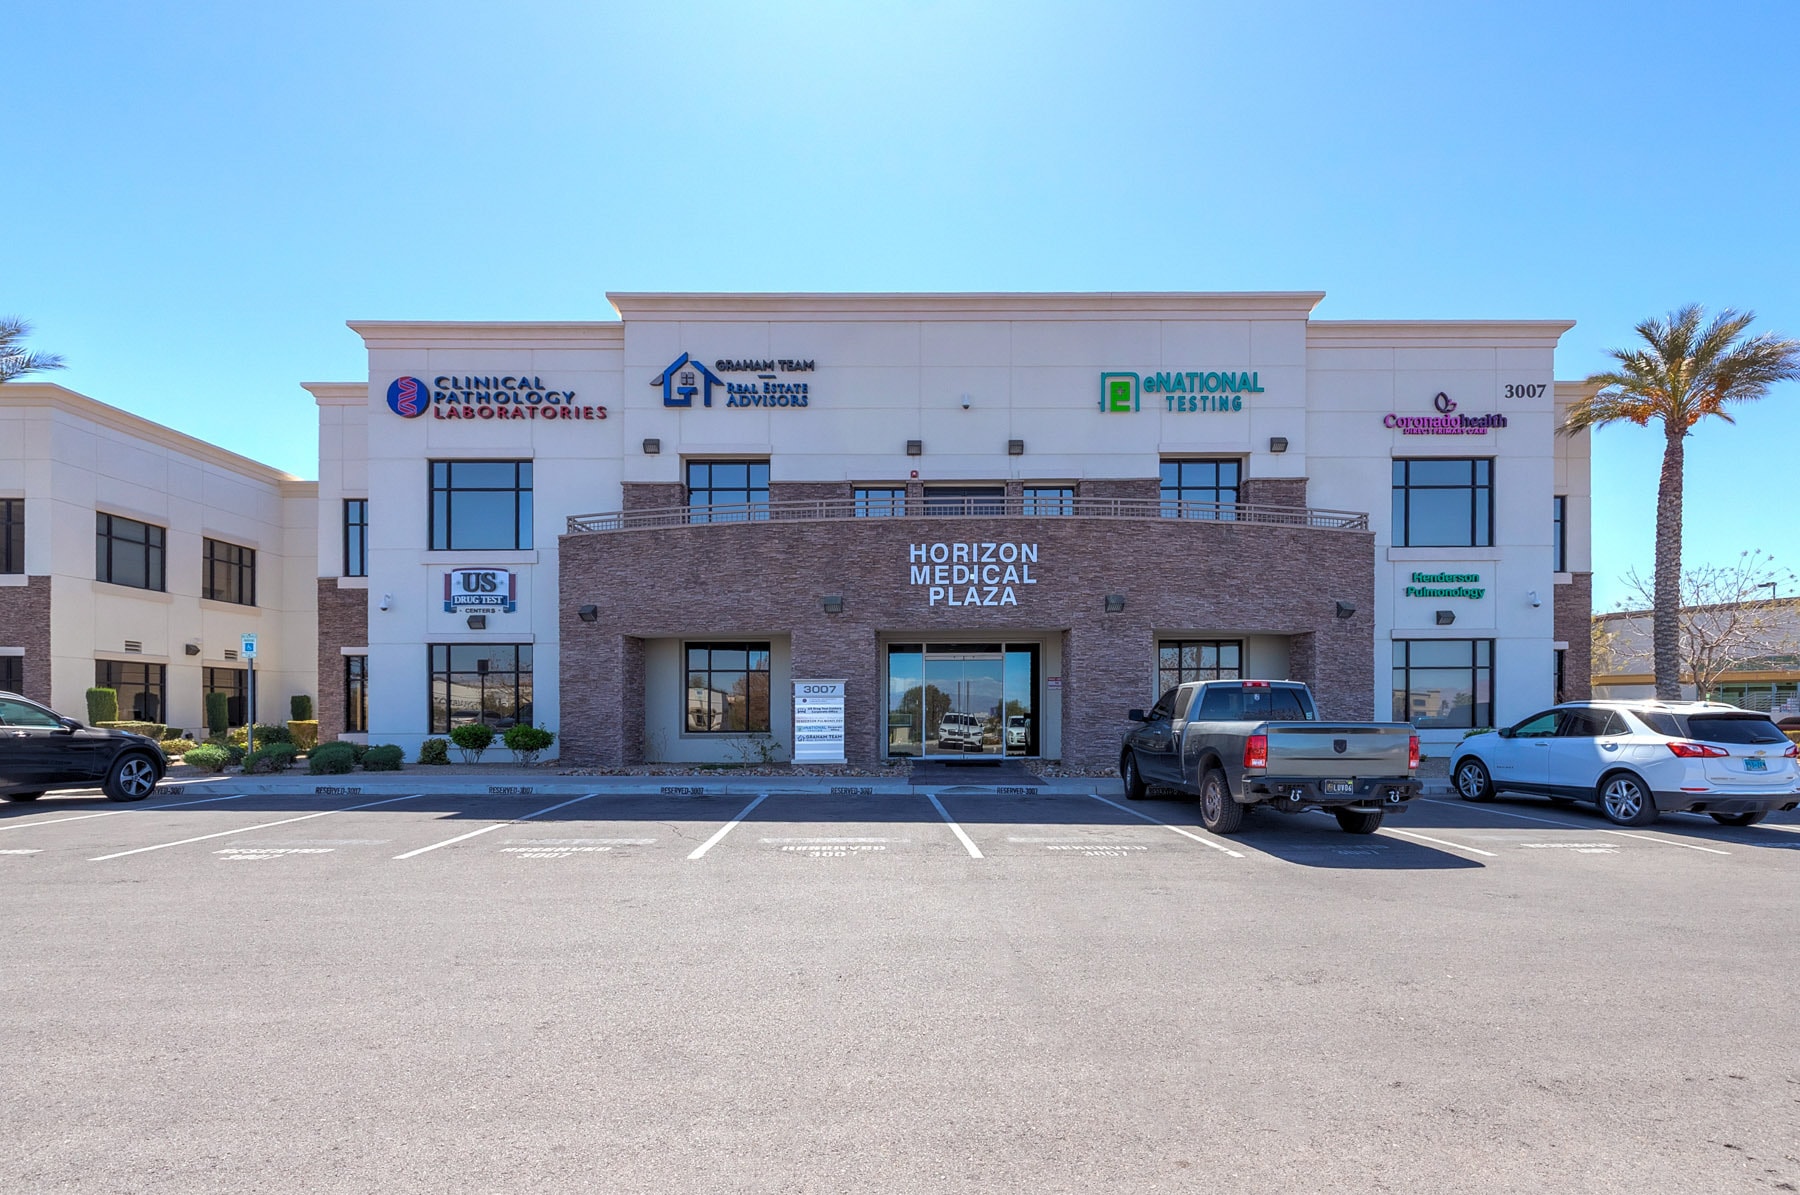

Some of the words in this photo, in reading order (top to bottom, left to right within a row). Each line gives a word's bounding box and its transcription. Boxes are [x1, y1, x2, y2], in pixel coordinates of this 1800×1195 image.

[715, 359, 775, 372] GRAHAM
[778, 359, 815, 372] TEAM
[433, 376, 546, 390] CLINICAL
[726, 382, 759, 394] REAL
[763, 382, 808, 394] ESTATE
[1143, 371, 1265, 393] eNATIONAL
[433, 390, 576, 405] PATHOLOGY
[1504, 384, 1547, 399] 3007
[726, 394, 808, 408] ADVISORS
[1165, 395, 1243, 412] TESTING
[433, 405, 608, 420] LABORATORIES
[909, 542, 1038, 563] HORIZON
[909, 564, 1037, 585] MEDICAL
[1412, 572, 1480, 583] Henderson
[460, 572, 497, 593] US
[454, 595, 479, 604] DRUG
[480, 595, 503, 604] TEST
[929, 586, 1018, 607] PLAZA
[1406, 586, 1486, 600] Pulmonology
[803, 685, 837, 694] 3007
